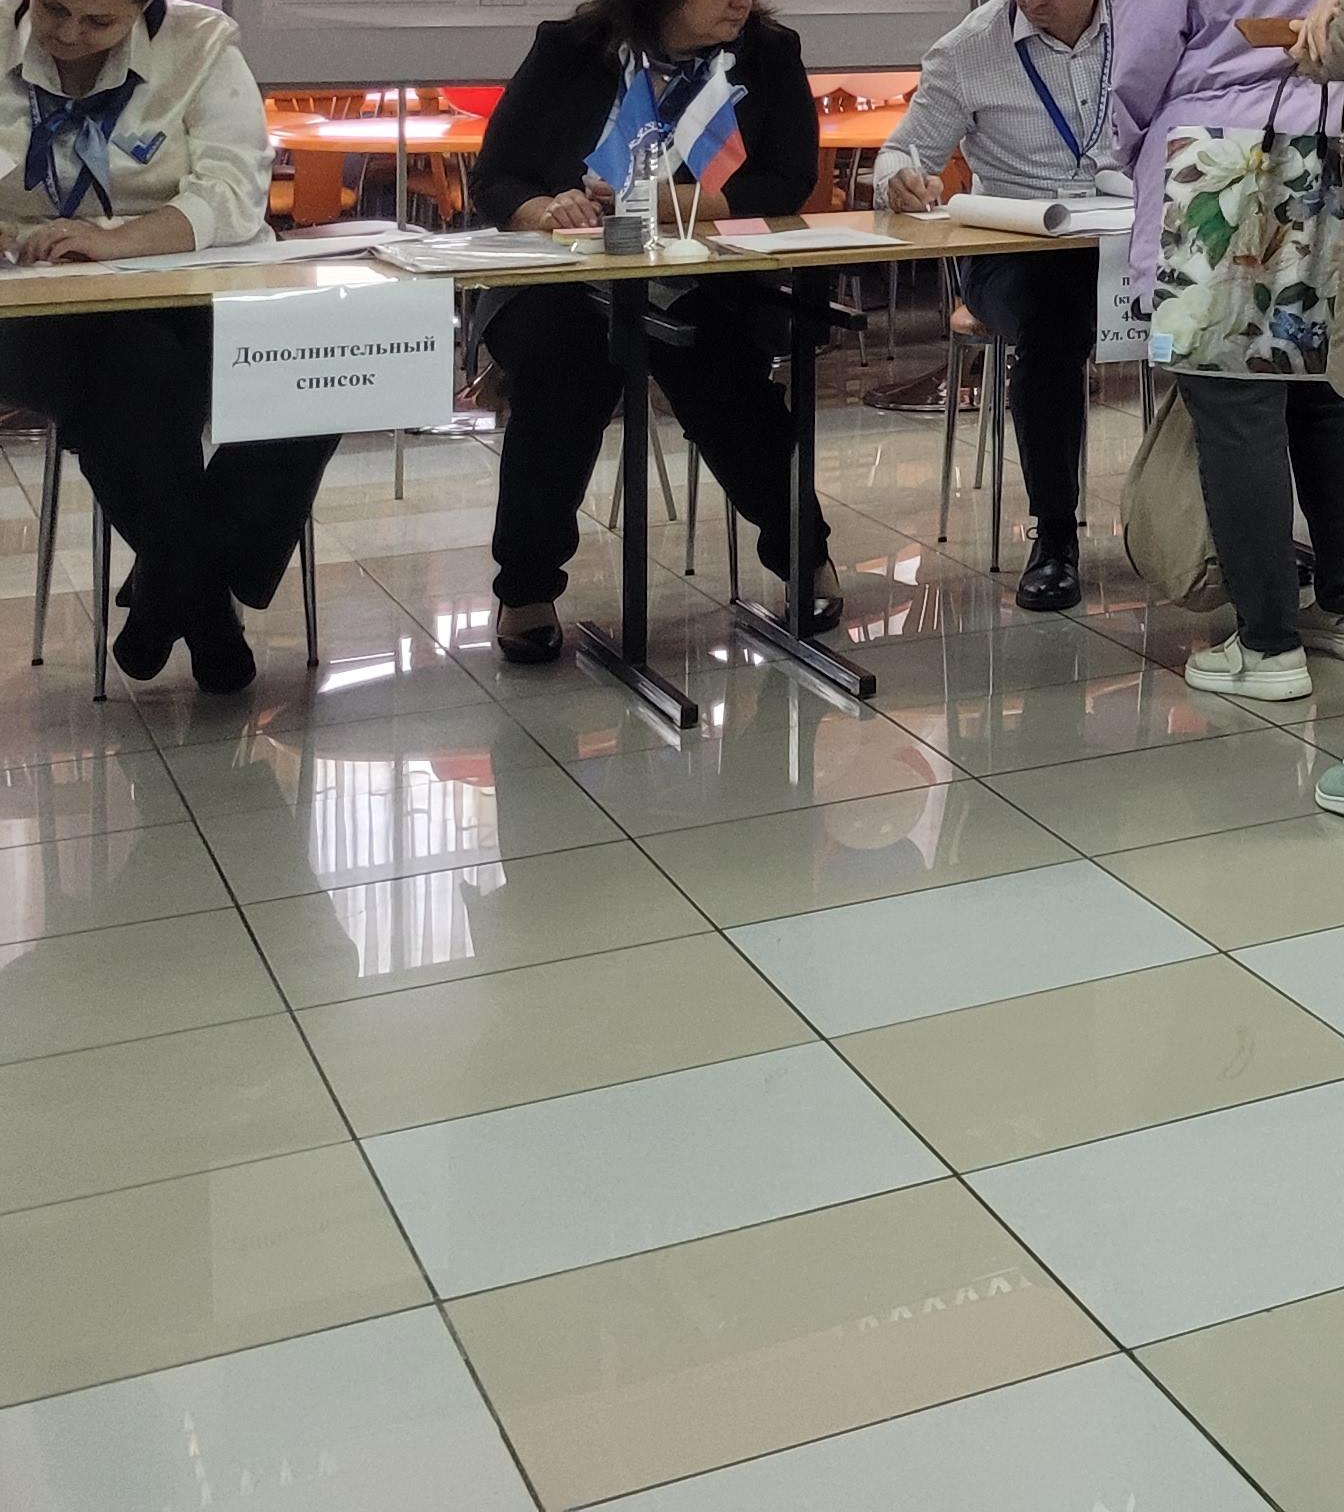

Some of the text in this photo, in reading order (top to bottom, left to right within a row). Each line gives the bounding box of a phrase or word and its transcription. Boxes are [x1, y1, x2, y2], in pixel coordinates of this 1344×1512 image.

[1101, 329, 1123, 342] Ул.
[232, 335, 436, 368] Дополнительный
[296, 372, 376, 390] список
